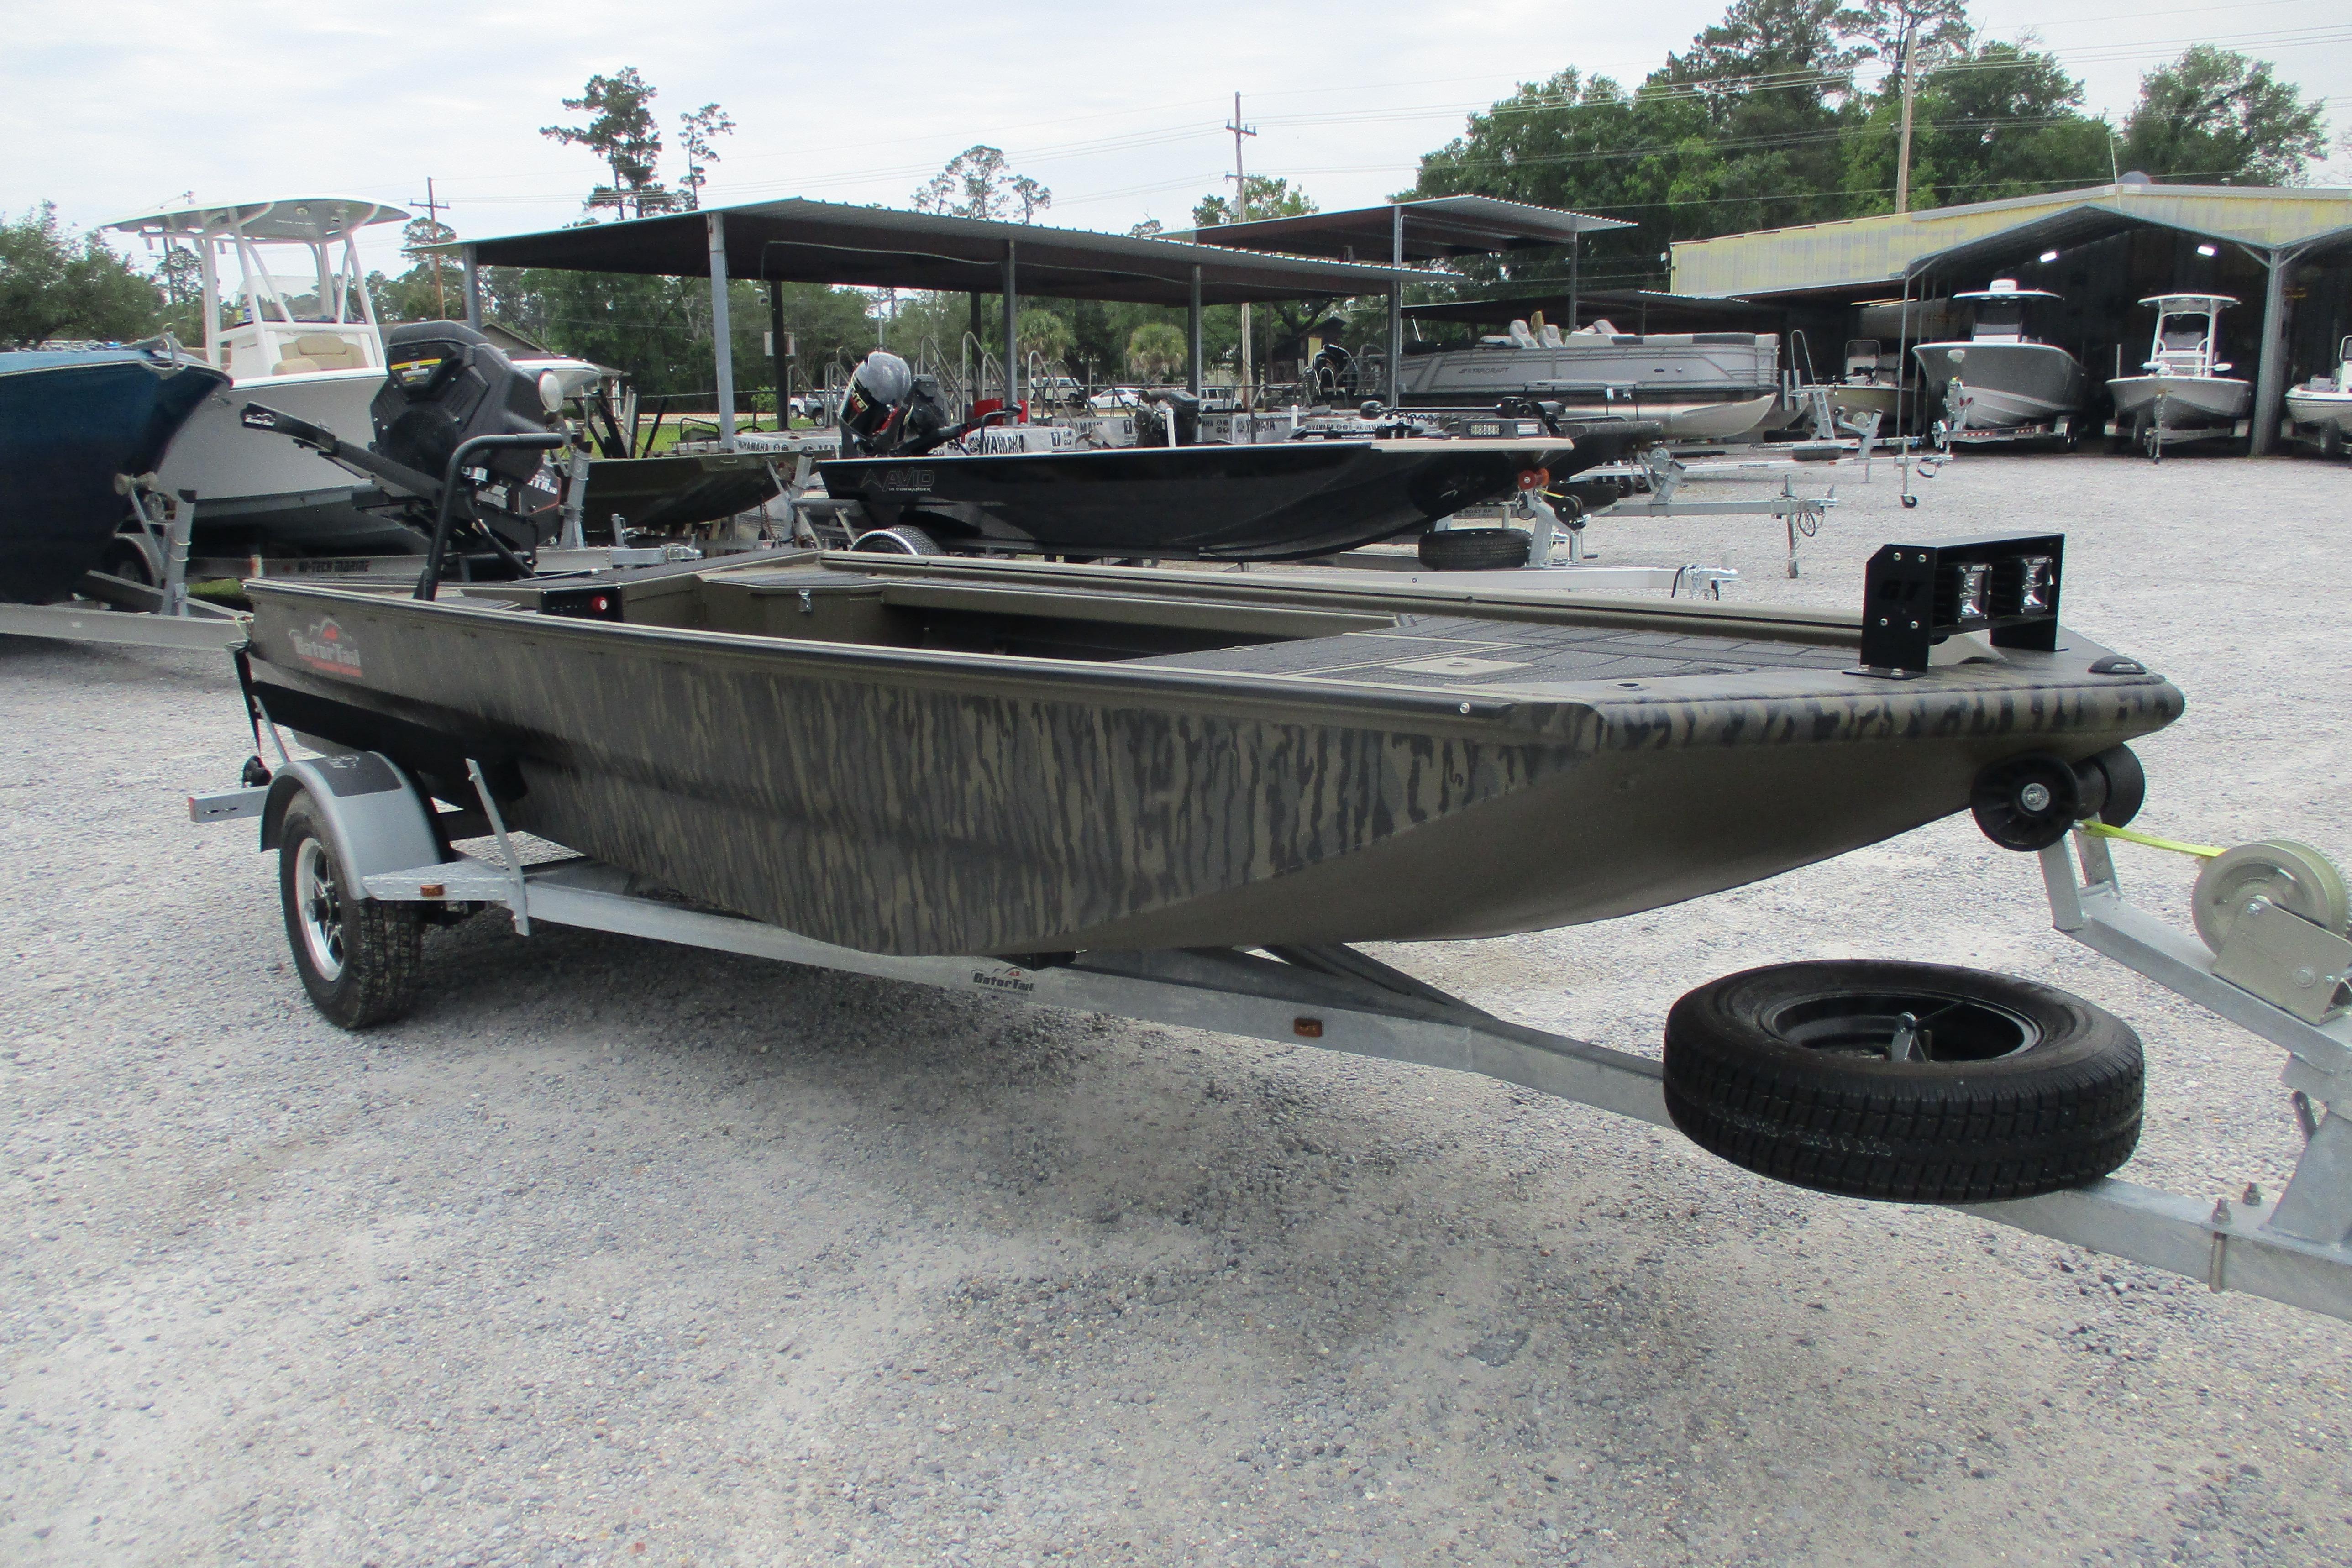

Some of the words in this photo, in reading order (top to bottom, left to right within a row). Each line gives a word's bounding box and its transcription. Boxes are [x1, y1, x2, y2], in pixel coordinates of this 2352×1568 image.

[743, 441, 769, 452] YAMAHA
[982, 435, 1025, 455] YAMAHA
[882, 467, 935, 492] AVID
[972, 972, 1034, 992] GatorTail
